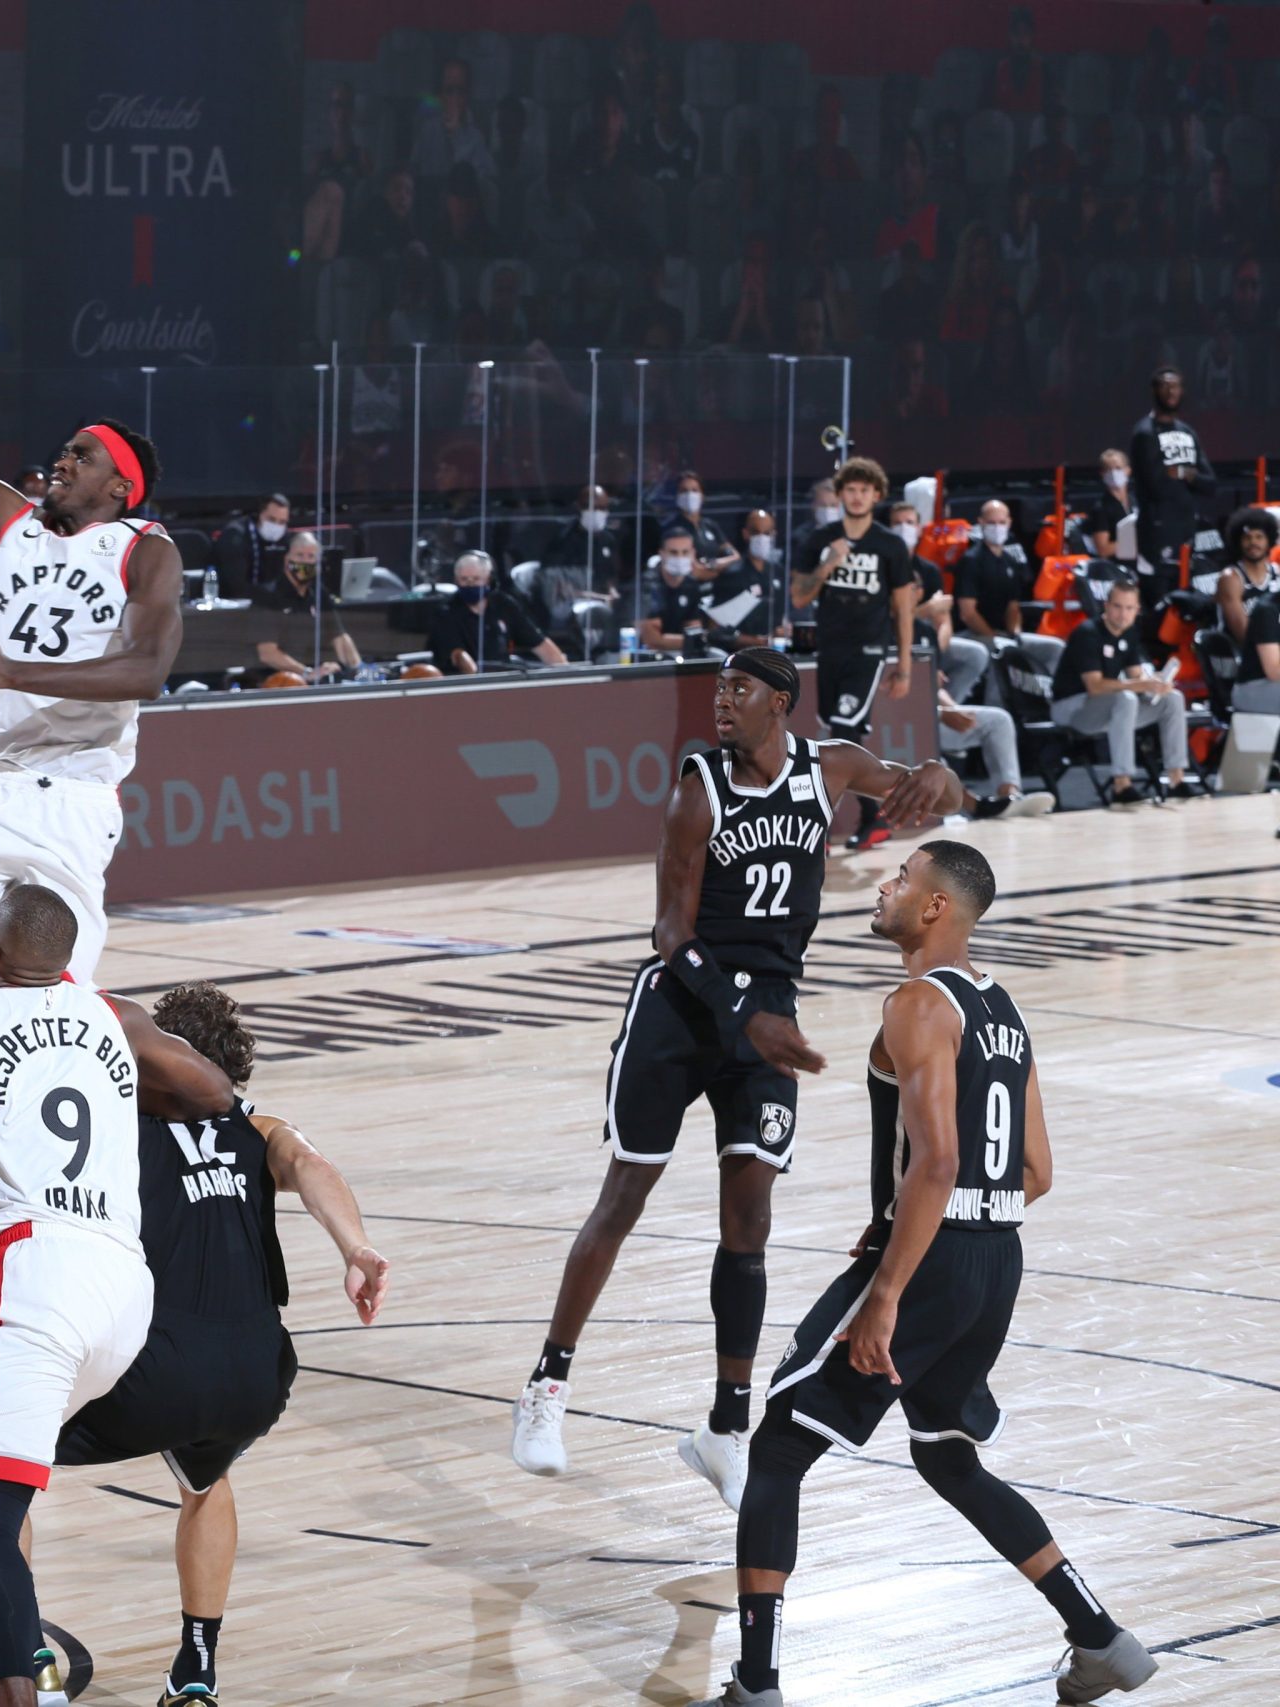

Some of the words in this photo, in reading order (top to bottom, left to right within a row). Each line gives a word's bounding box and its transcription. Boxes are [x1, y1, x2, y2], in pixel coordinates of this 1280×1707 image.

[61, 143, 233, 197] ULTRA
[71, 299, 217, 366] Courtside
[8, 603, 75, 658] 43
[117, 768, 342, 850] RDASH
[791, 781, 813, 794] infor
[708, 814, 824, 868] BROOKLYN
[744, 861, 793, 918] 22
[95, 1034, 134, 1099] BISO
[40, 1086, 92, 1182] 9
[763, 1105, 792, 1128] NETS
[984, 1081, 1011, 1181] 9
